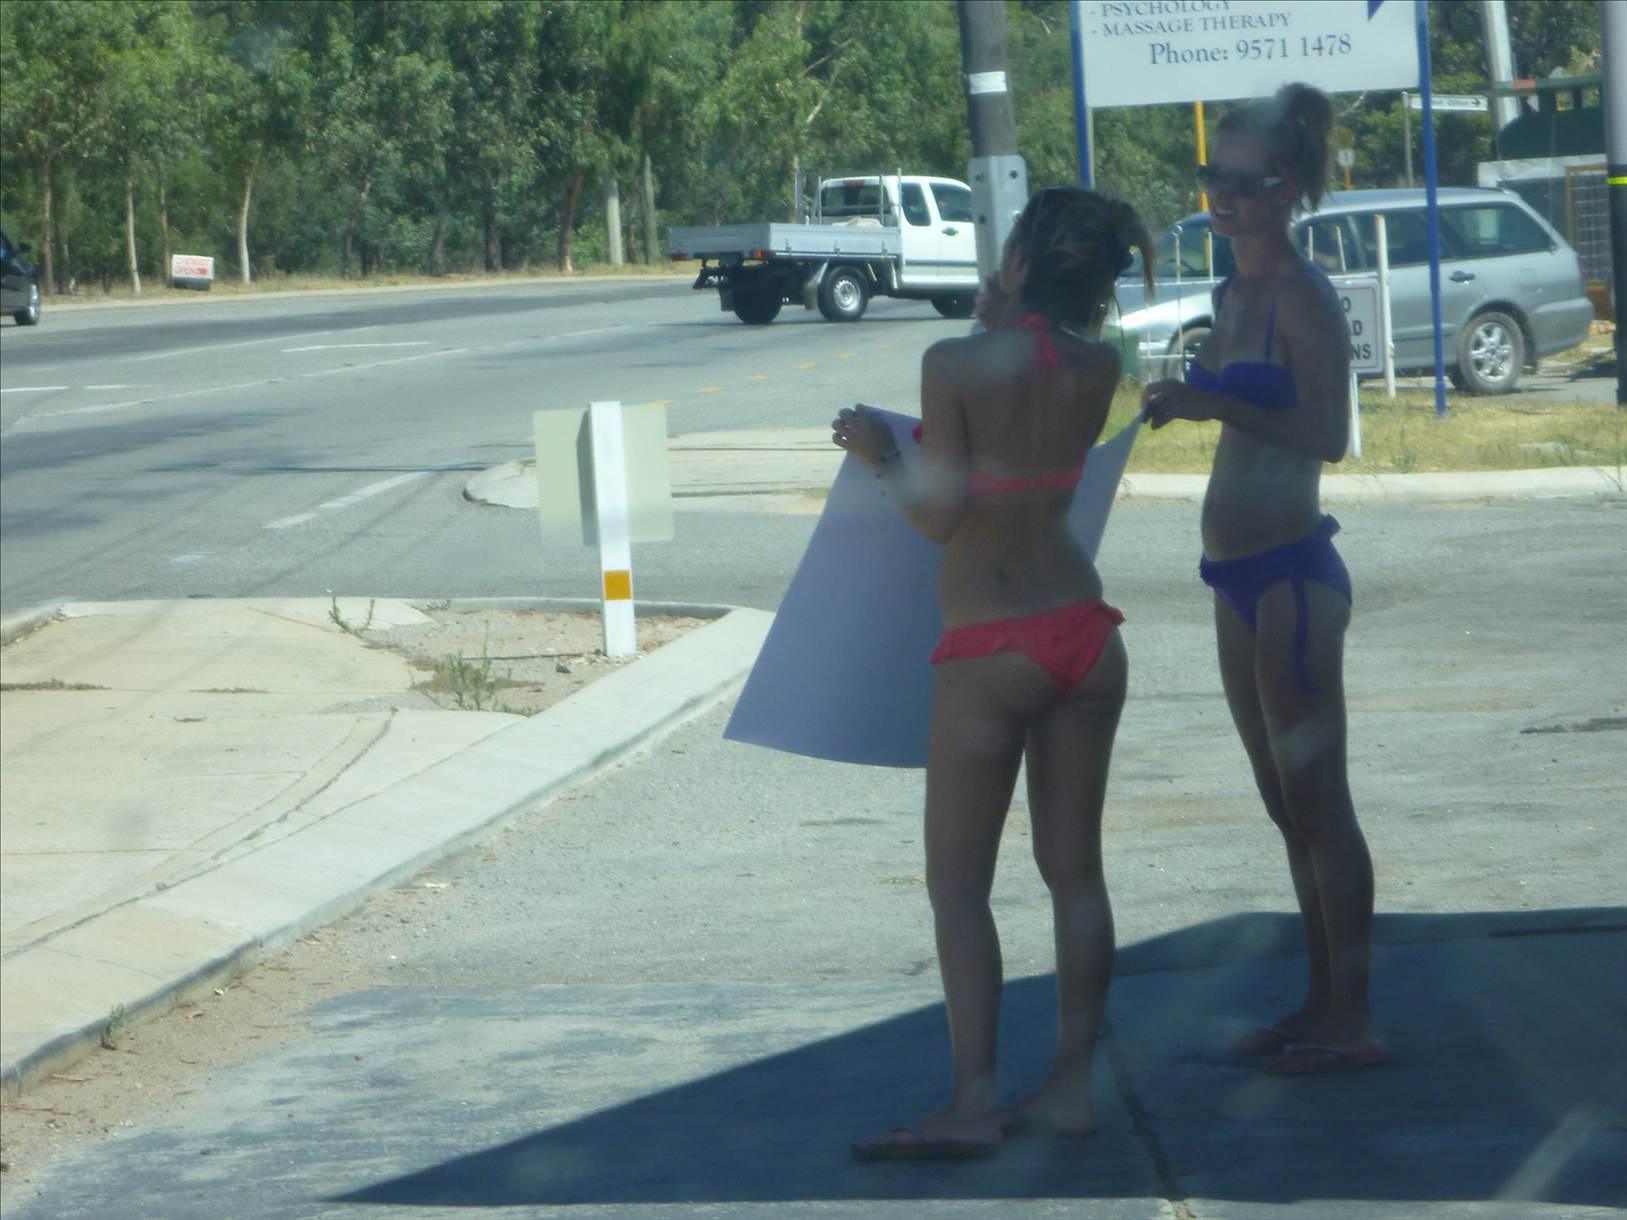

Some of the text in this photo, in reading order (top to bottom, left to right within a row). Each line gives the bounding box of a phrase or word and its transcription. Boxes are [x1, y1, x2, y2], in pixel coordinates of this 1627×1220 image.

[1101, 0, 1231, 17] PSYCHOLOGY
[1102, 18, 1194, 37] MASSAGE
[1199, 12, 1290, 31] THERAPY
[1149, 33, 1352, 65] Phone: 9571 1478
